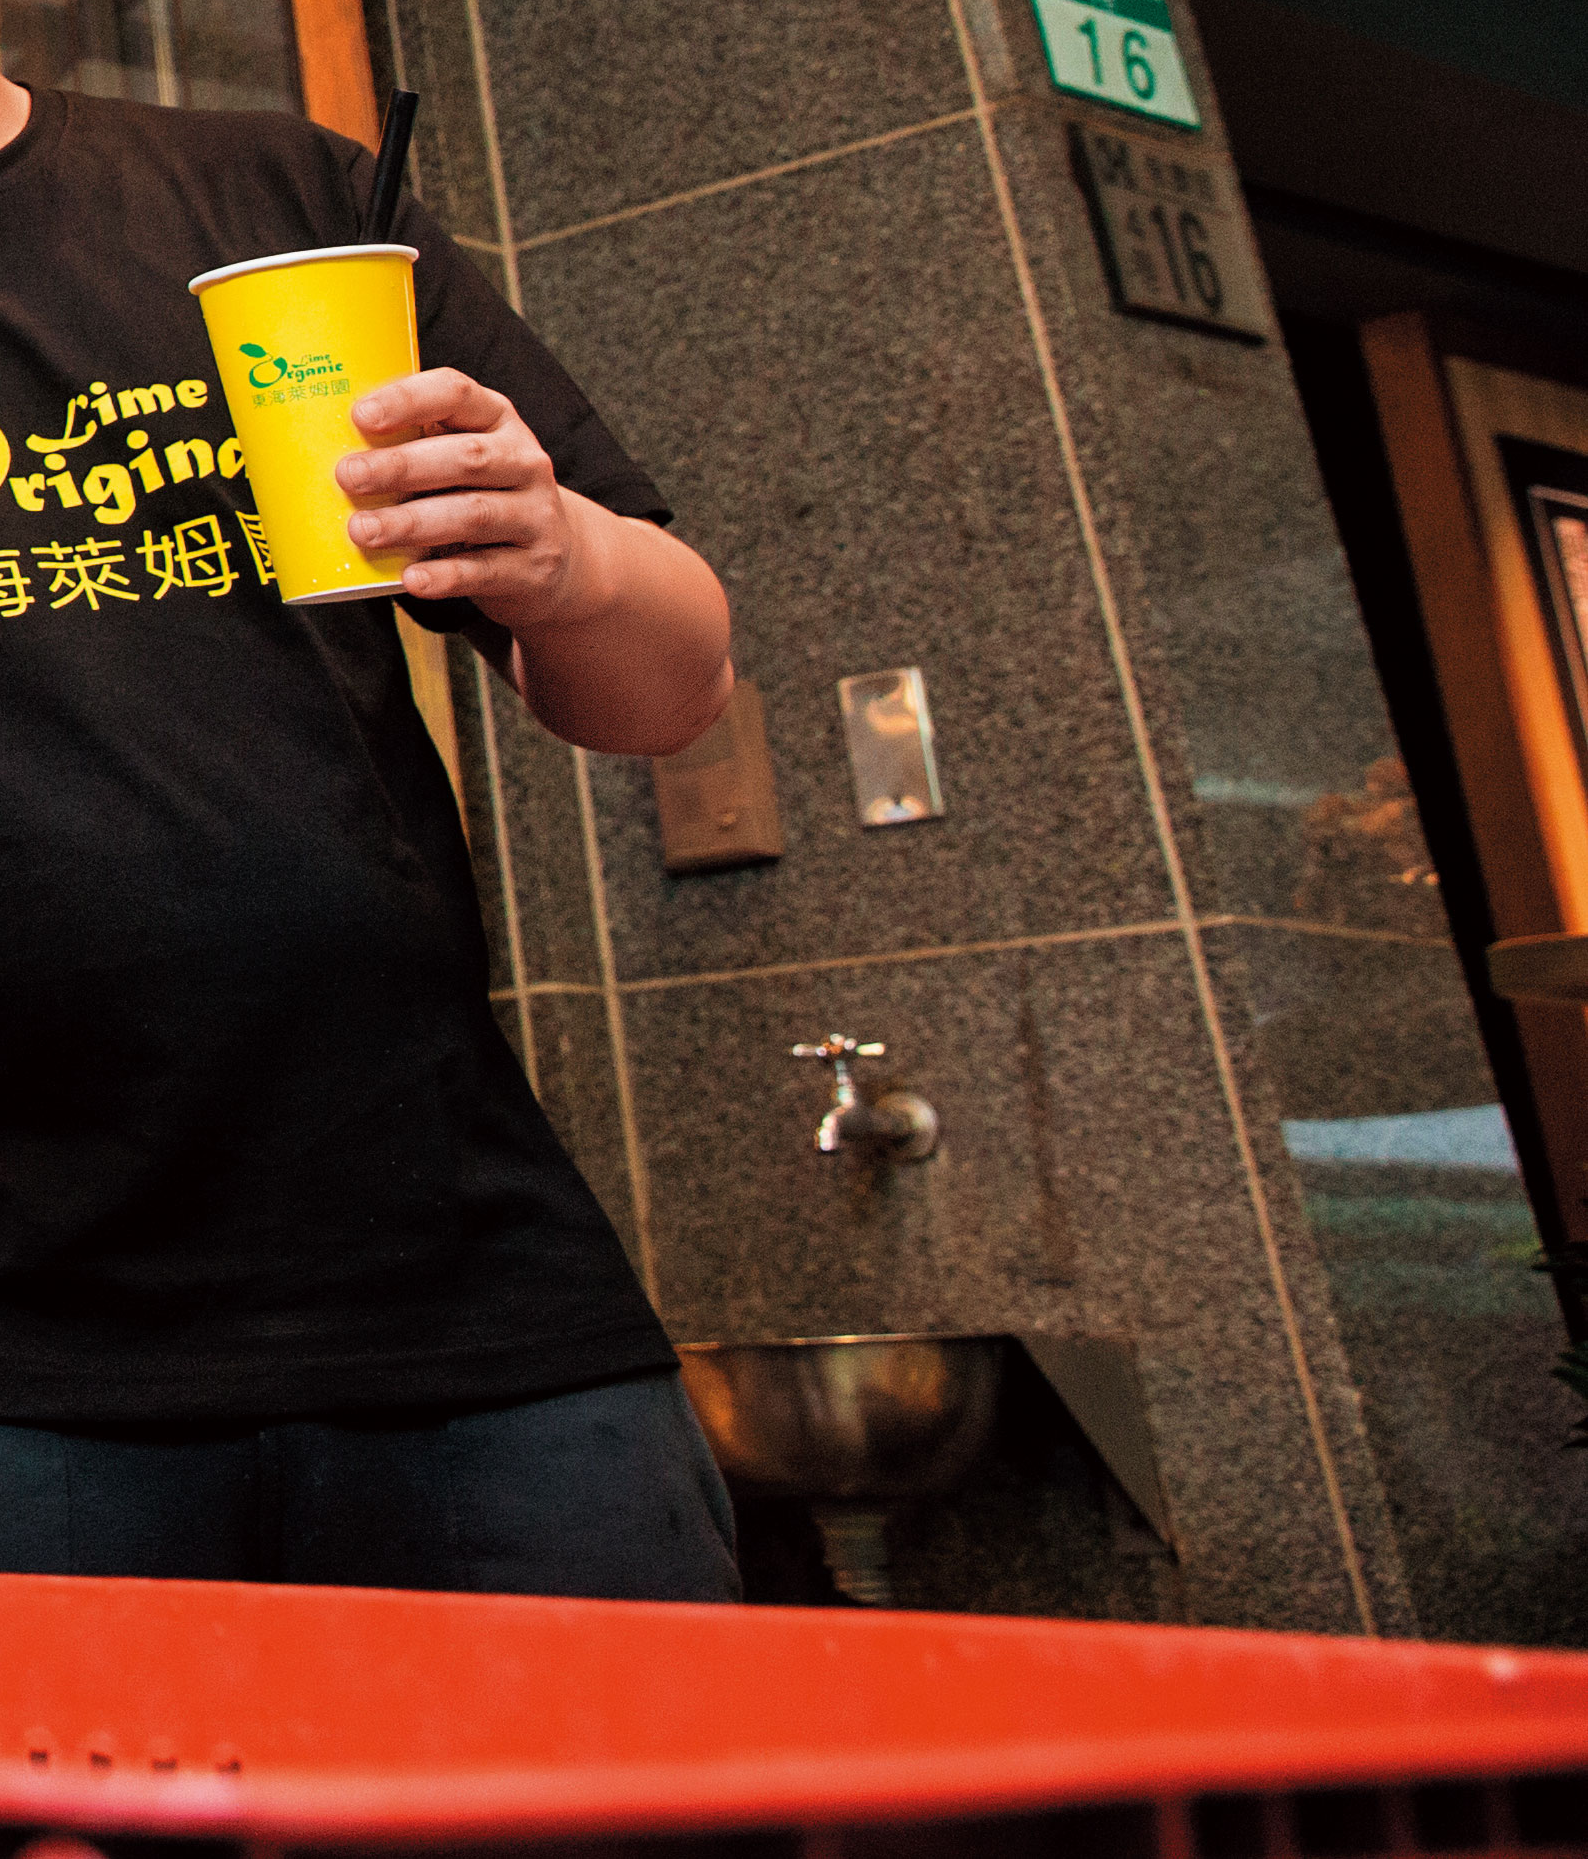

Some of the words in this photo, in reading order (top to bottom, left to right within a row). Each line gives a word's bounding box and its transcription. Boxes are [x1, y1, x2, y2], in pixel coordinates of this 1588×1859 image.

[1077, 15, 1156, 101] 16
[249, 356, 344, 388] Organic
[293, 352, 331, 369] Lime
[251, 377, 351, 409] 東海萊姆園
[27, 379, 208, 453] Lime
